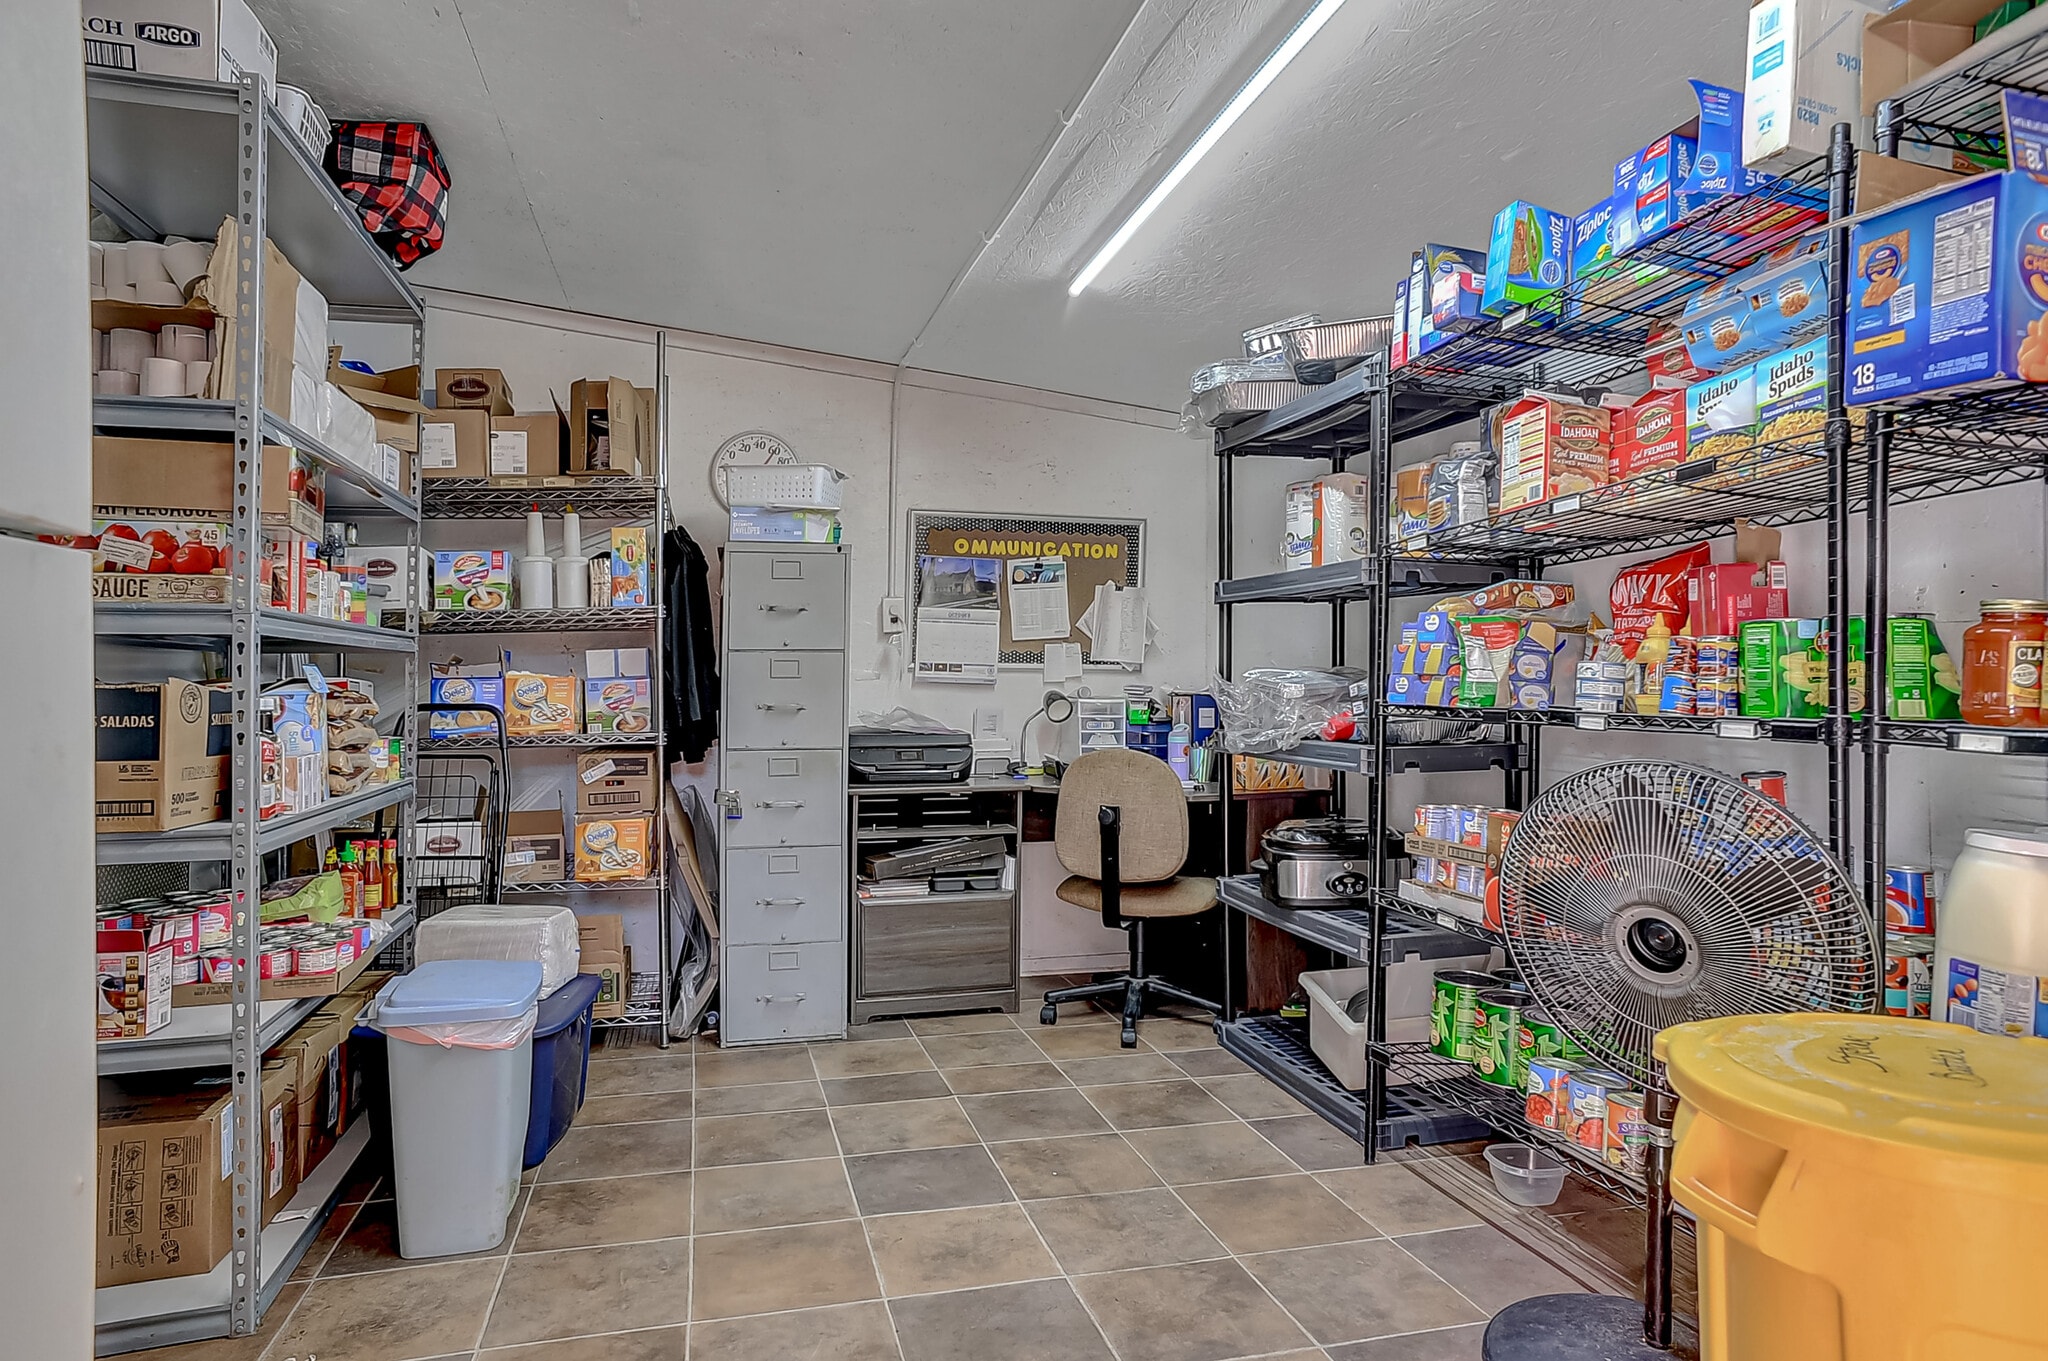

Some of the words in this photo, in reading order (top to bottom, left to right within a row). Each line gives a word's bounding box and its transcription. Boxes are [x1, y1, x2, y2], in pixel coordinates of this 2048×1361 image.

[1677, 142, 1691, 179] Ziploc
[1700, 176, 1728, 189] Ziploc
[1576, 205, 1613, 248] Ziploc
[1549, 215, 1563, 257] Ziploc
[1769, 350, 1814, 383] Idaho
[1852, 362, 1875, 387] 18
[1768, 365, 1814, 399] Spuds
[1697, 378, 1738, 407] Idaho
[1560, 425, 1599, 439] IDAHOAN
[1636, 413, 1672, 439] IDAHOAN
[738, 443, 751, 453] 20
[753, 440, 766, 450] 40
[768, 445, 781, 455] 60
[203, 529, 218, 541] 45
[953, 537, 1119, 559] OMMUNICATION
[443, 683, 474, 700] Delight
[516, 680, 546, 694] Delight
[100, 715, 155, 728] SALADAS
[171, 792, 185, 805] 500
[587, 829, 616, 844] Delight
